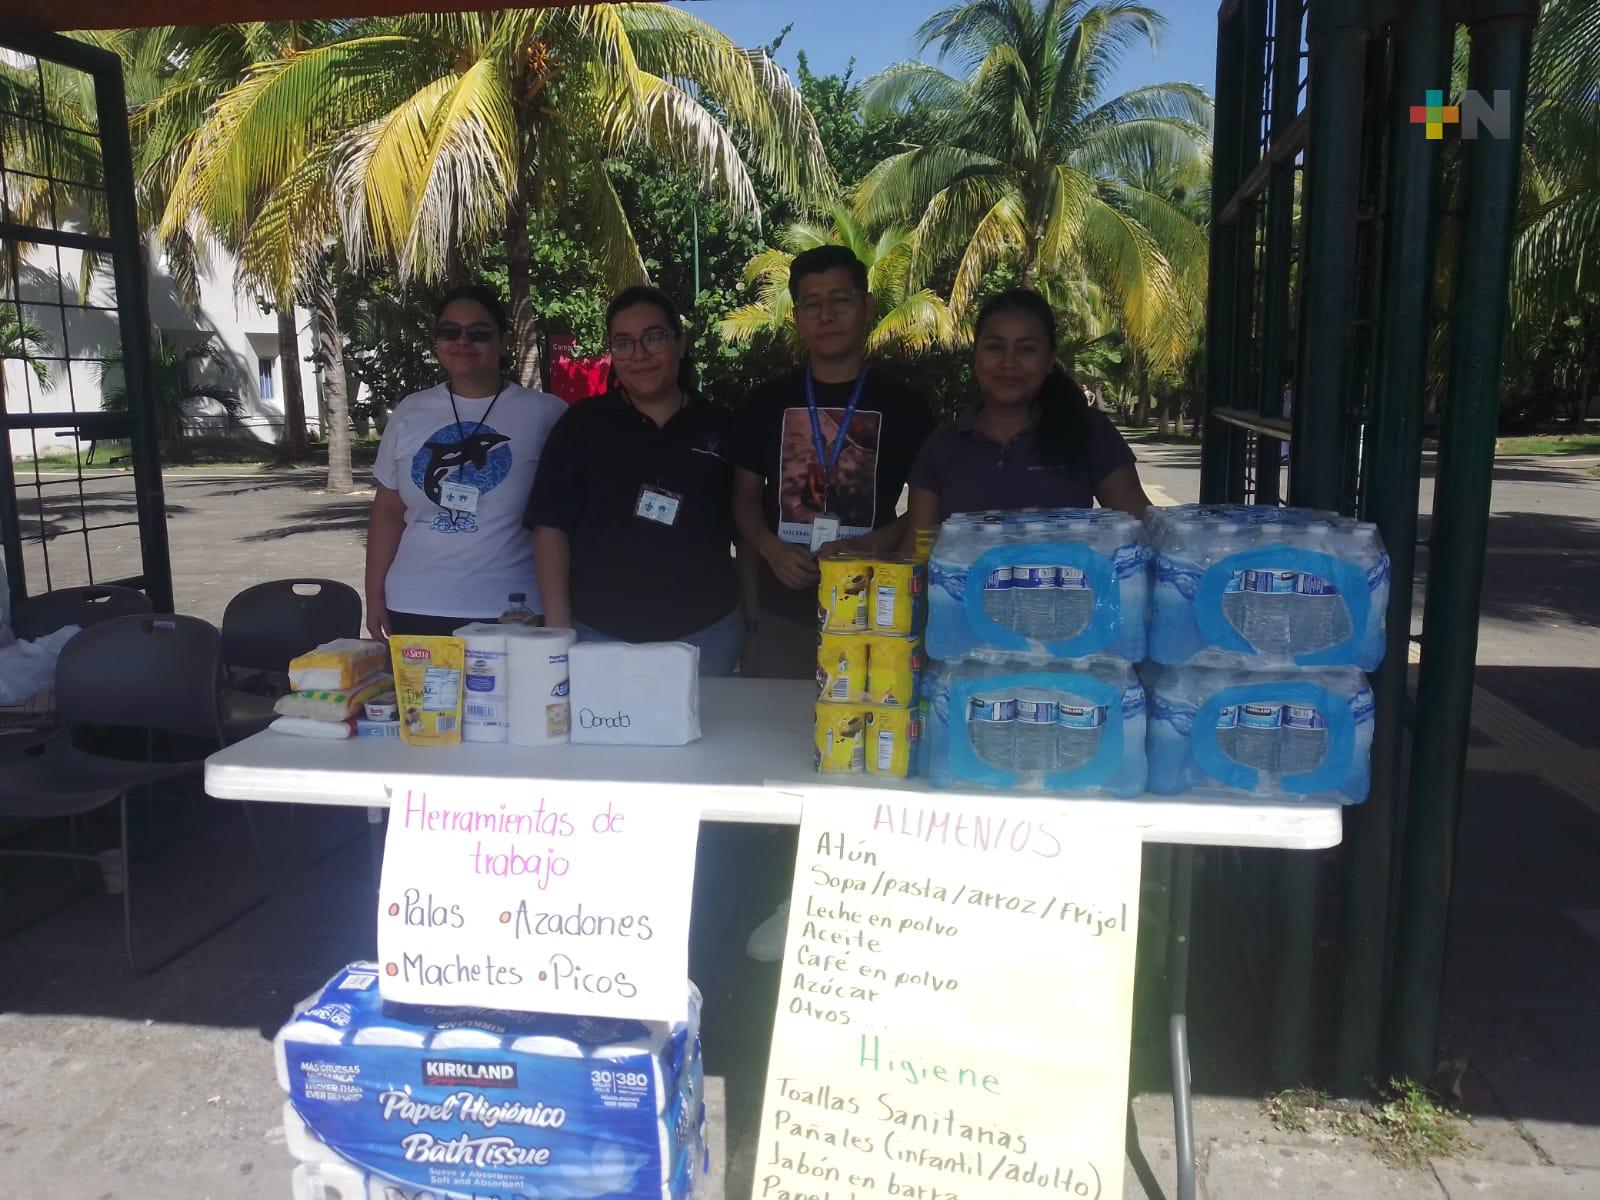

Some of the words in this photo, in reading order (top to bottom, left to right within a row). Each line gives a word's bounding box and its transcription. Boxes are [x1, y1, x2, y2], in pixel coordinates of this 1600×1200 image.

[405, 790, 575, 837] Herramientas
[592, 801, 625, 833] de
[469, 841, 569, 890] trabajo
[816, 831, 877, 866] Atún
[404, 888, 464, 928] Palas
[515, 899, 653, 940] Azadones
[806, 896, 862, 924] Leche
[868, 911, 892, 929] en
[899, 916, 958, 937] polvo
[802, 921, 882, 953] Aceite
[402, 952, 523, 986] Machetes
[549, 953, 637, 998] Picos
[793, 973, 880, 1002] Azúcar
[798, 944, 848, 972] Café
[858, 965, 887, 981] en
[895, 971, 958, 992] polvo
[426, 1062, 514, 1080] KIRKLAND
[591, 1070, 612, 1083] 30
[615, 1072, 648, 1086] 380
[860, 1033, 1000, 1095] Higiene
[379, 1090, 459, 1126] Papel
[457, 1092, 566, 1128] Higiénico
[777, 1077, 860, 1114] Toallas
[877, 1093, 1027, 1154] Sanitarias
[401, 1133, 472, 1165] Bath
[468, 1137, 550, 1168] Tissue
[775, 1109, 874, 1153] Pañales
[431, 1176, 450, 1185] Soft
[453, 1178, 472, 1186] and
[474, 1178, 525, 1189] Absorbent
[768, 1141, 839, 1182] Jabón
[849, 1173, 875, 1190] en
[888, 1172, 959, 1200] barra
